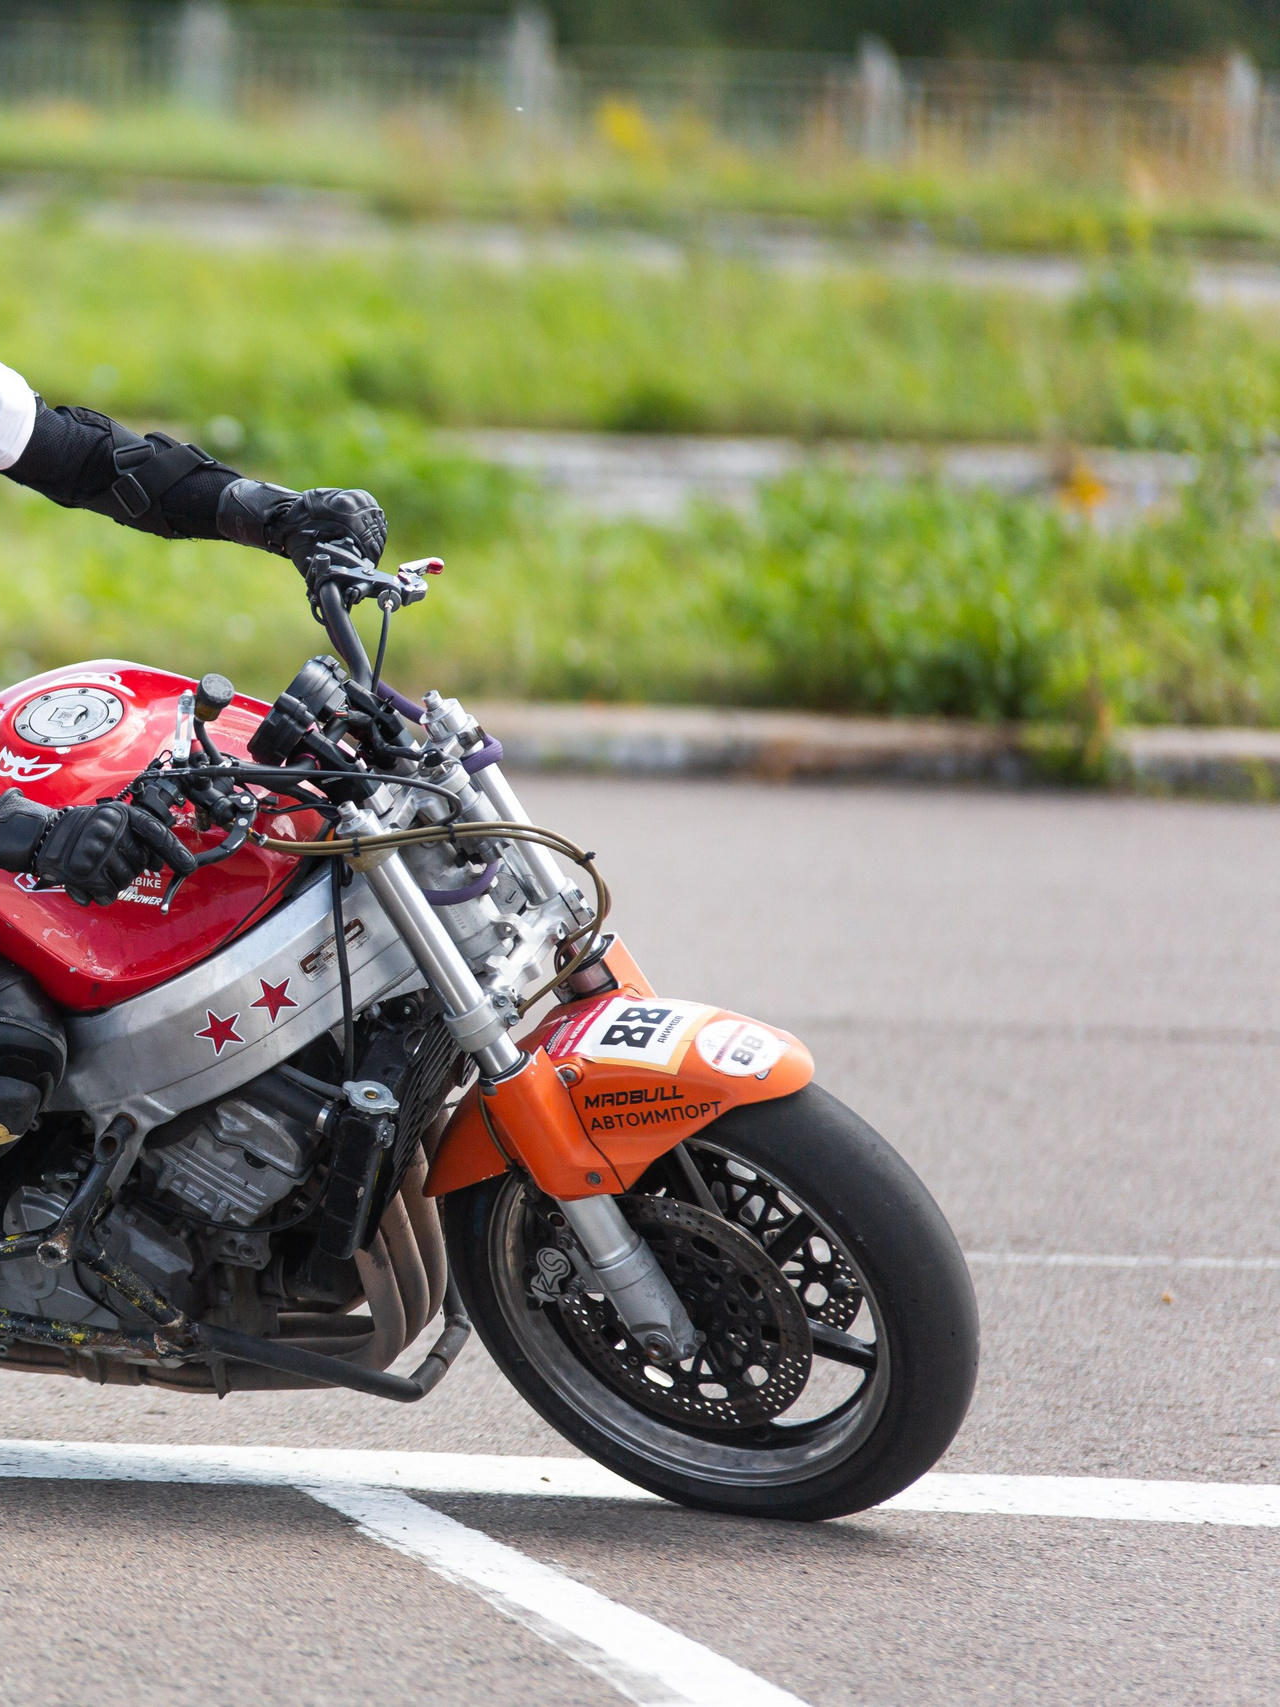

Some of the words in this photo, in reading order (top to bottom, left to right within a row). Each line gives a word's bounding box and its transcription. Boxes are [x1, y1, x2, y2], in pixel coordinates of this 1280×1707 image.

[132, 877, 161, 889] BIKE
[600, 1007, 673, 1048] 88
[730, 1034, 764, 1066] 88
[584, 1085, 684, 1109] MADBULL
[590, 1101, 722, 1131] АВТОИМПОРТ
